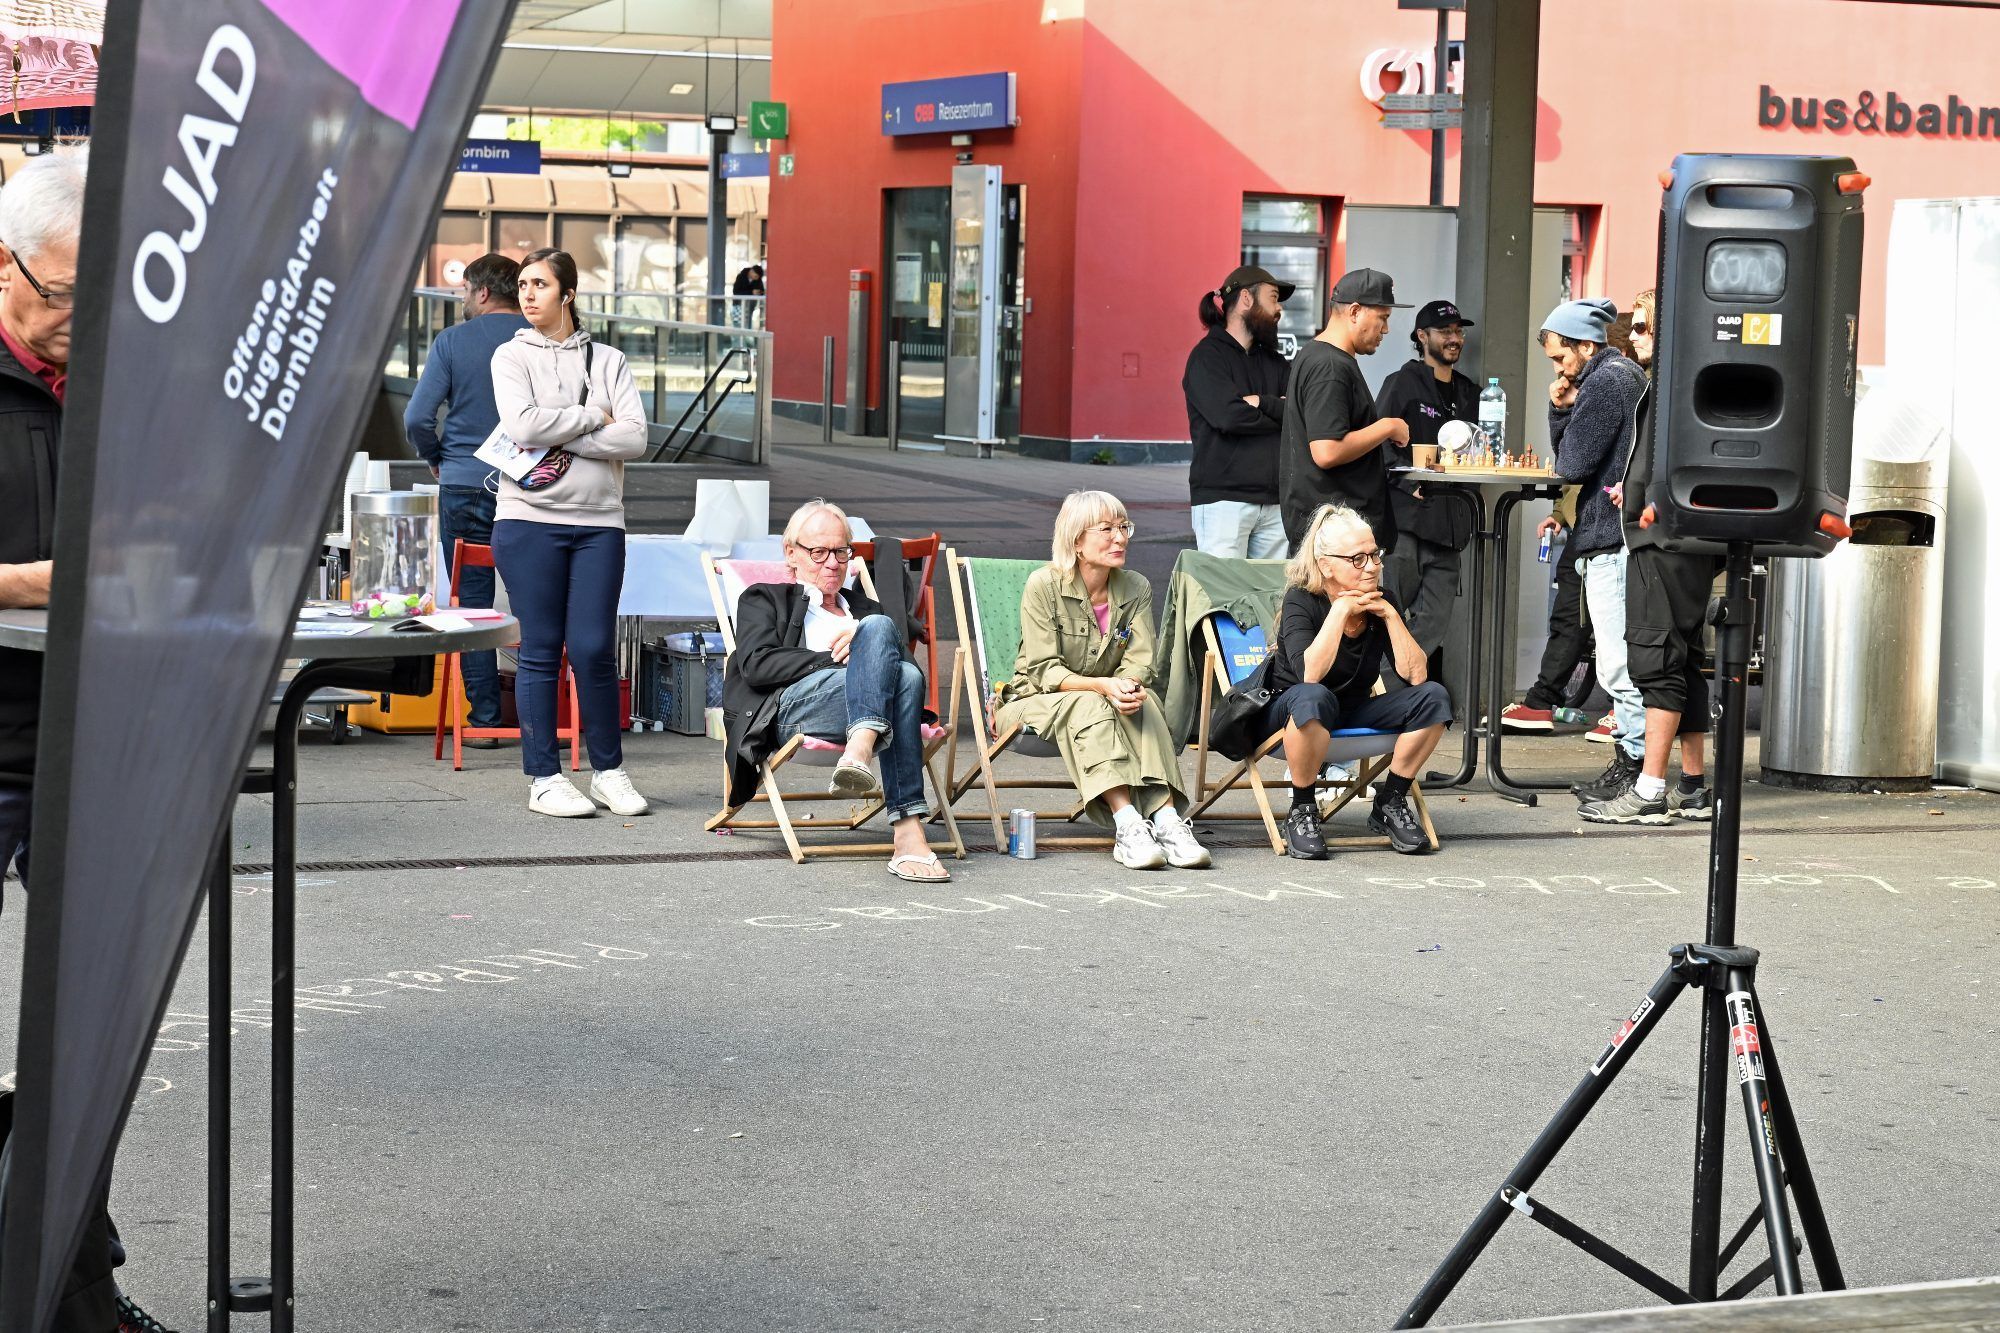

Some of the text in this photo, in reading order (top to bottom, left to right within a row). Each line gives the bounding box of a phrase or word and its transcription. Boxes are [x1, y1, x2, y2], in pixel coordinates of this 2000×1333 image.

[895, 101, 993, 124] 1 ÖBB Reisezentrum
[1758, 84, 2000, 138] bus&bahn
[132, 24, 257, 324] OJAD
[462, 145, 510, 159] ornbirn
[1710, 253, 1782, 286] OJAD
[244, 168, 339, 423] JugendArbeit
[223, 278, 277, 400] Offene
[1717, 315, 1742, 325] OJAD
[260, 276, 336, 442] Dornbirn
[1737, 1054, 1749, 1081] OJAD
[1763, 1111, 1776, 1156] PROEL
